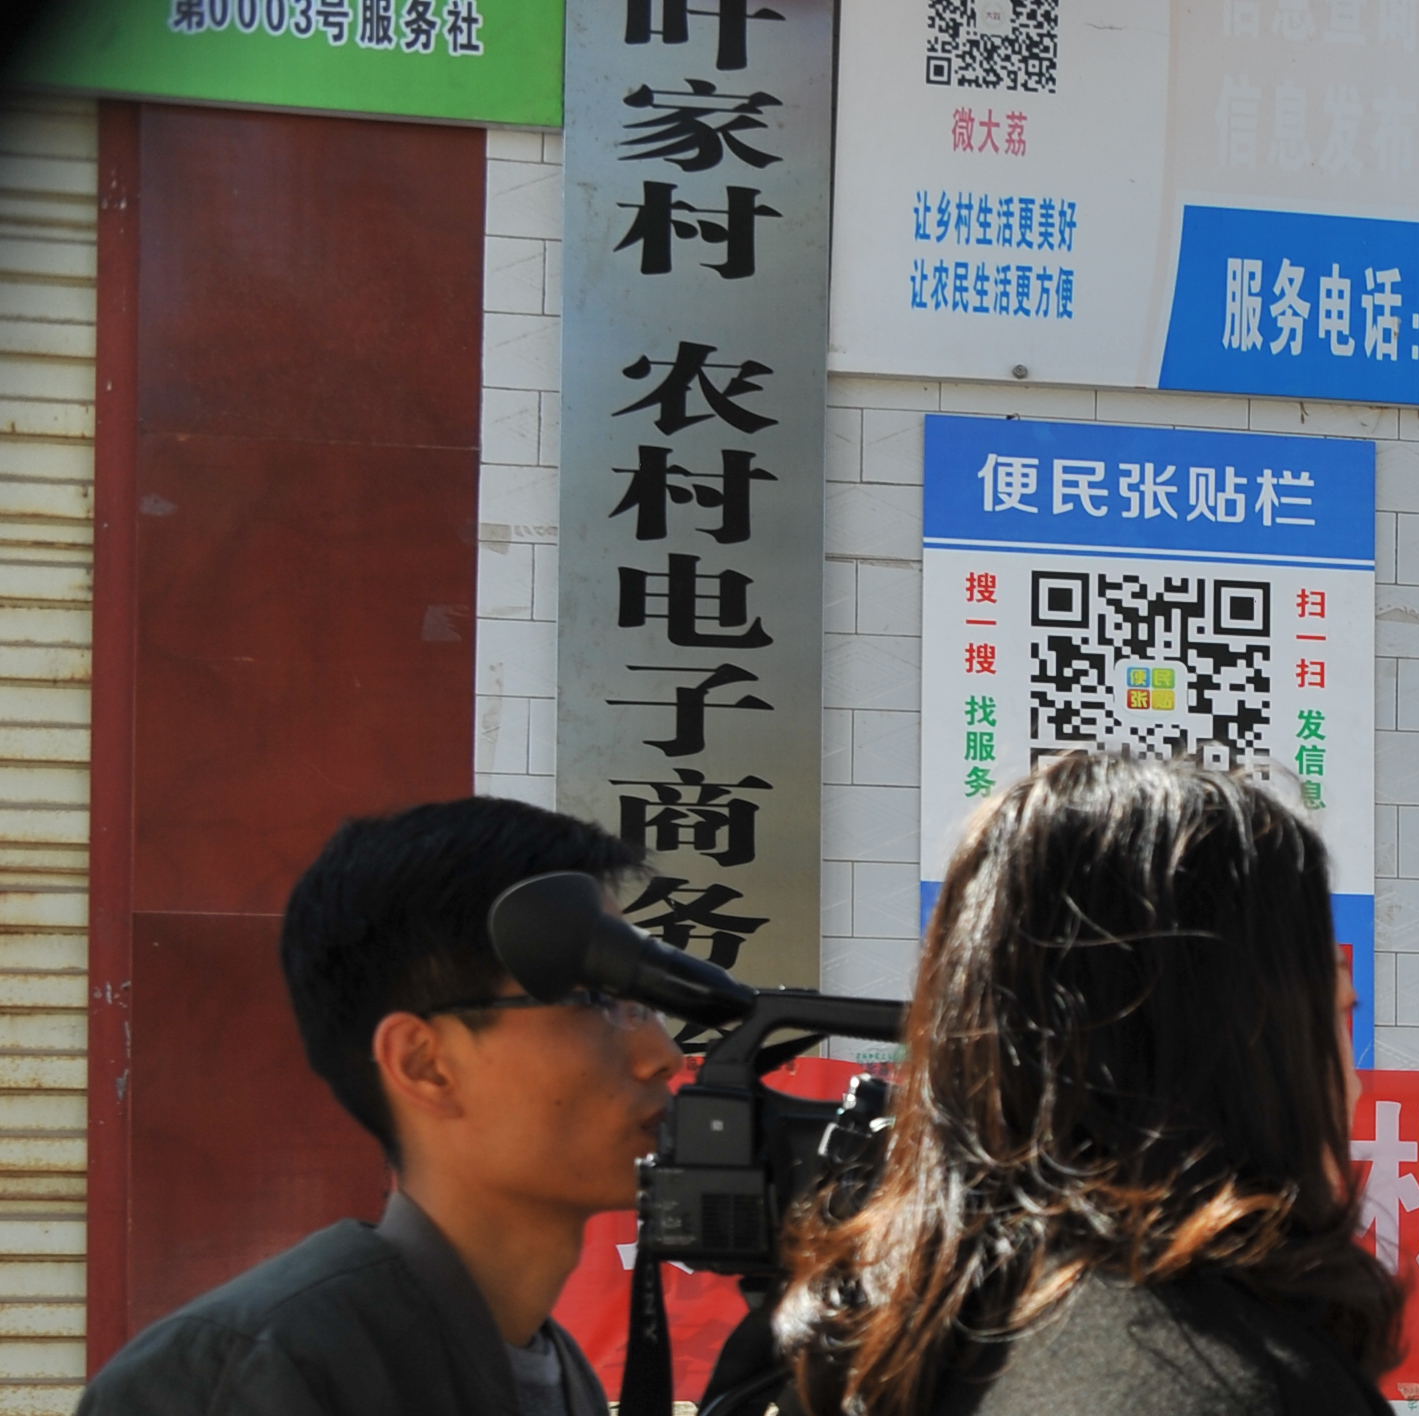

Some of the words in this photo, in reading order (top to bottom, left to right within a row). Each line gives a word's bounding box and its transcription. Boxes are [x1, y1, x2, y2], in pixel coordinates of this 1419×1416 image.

[613, 0, 786, 279] 叶家村
[951, 106, 1028, 157] 微大荔
[913, 189, 1078, 253] 让乡村生活更美好
[909, 258, 1075, 320] 让农民生活更方便
[976, 453, 1316, 528] 便民张贴栏
[965, 571, 998, 676] 搜一搜
[1296, 588, 1327, 689] 扫一扫
[604, 341, 779, 1053] 农村电子商务
[963, 695, 998, 799] 找服务
